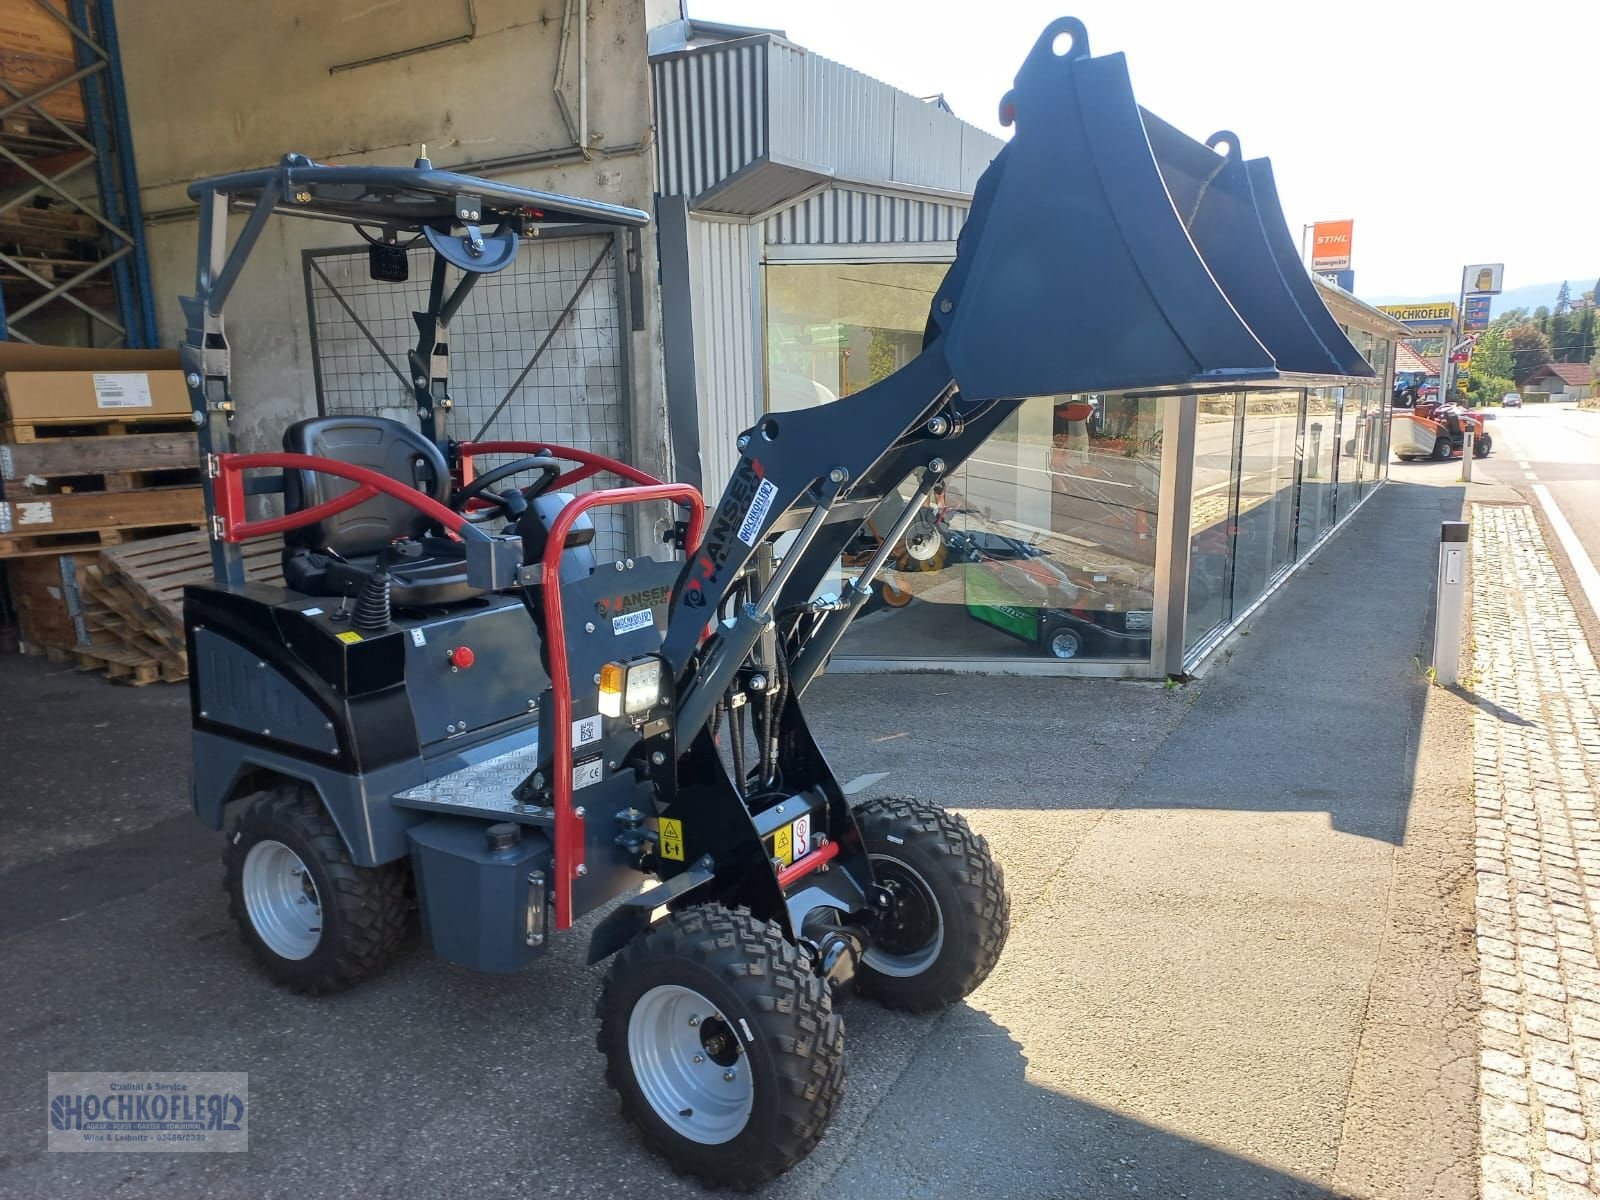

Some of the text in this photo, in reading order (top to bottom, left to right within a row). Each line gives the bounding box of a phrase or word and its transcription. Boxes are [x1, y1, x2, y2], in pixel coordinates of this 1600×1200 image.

[1316, 234, 1347, 245] STIHL
[699, 457, 755, 579] JANSEN
[613, 586, 669, 612] JANSEN
